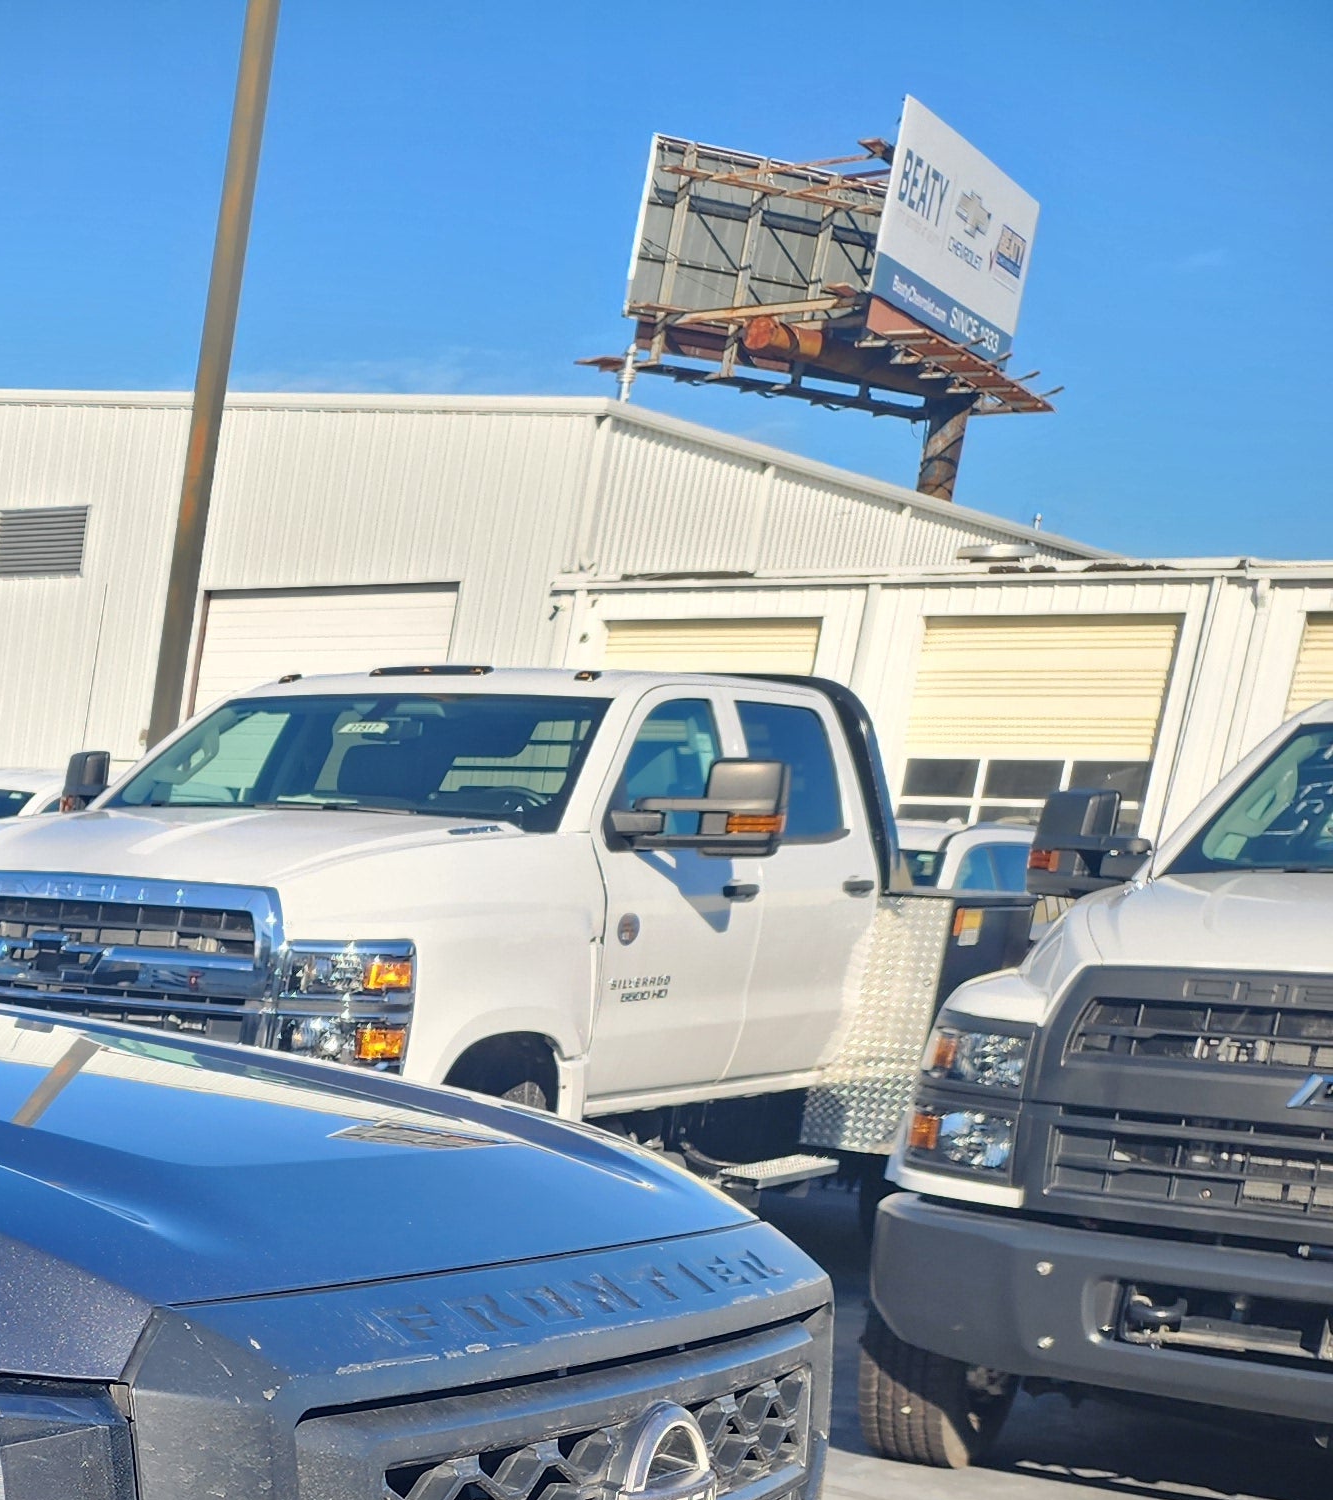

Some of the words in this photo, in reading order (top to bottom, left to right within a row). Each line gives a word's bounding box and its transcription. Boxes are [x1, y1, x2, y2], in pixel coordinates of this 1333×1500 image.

[897, 147, 950, 227] BEATY
[948, 236, 983, 272] CHEVROLET
[949, 306, 980, 341] SINCE
[609, 975, 671, 990] SILVERADO
[370, 1249, 785, 1345] FRONTIER
